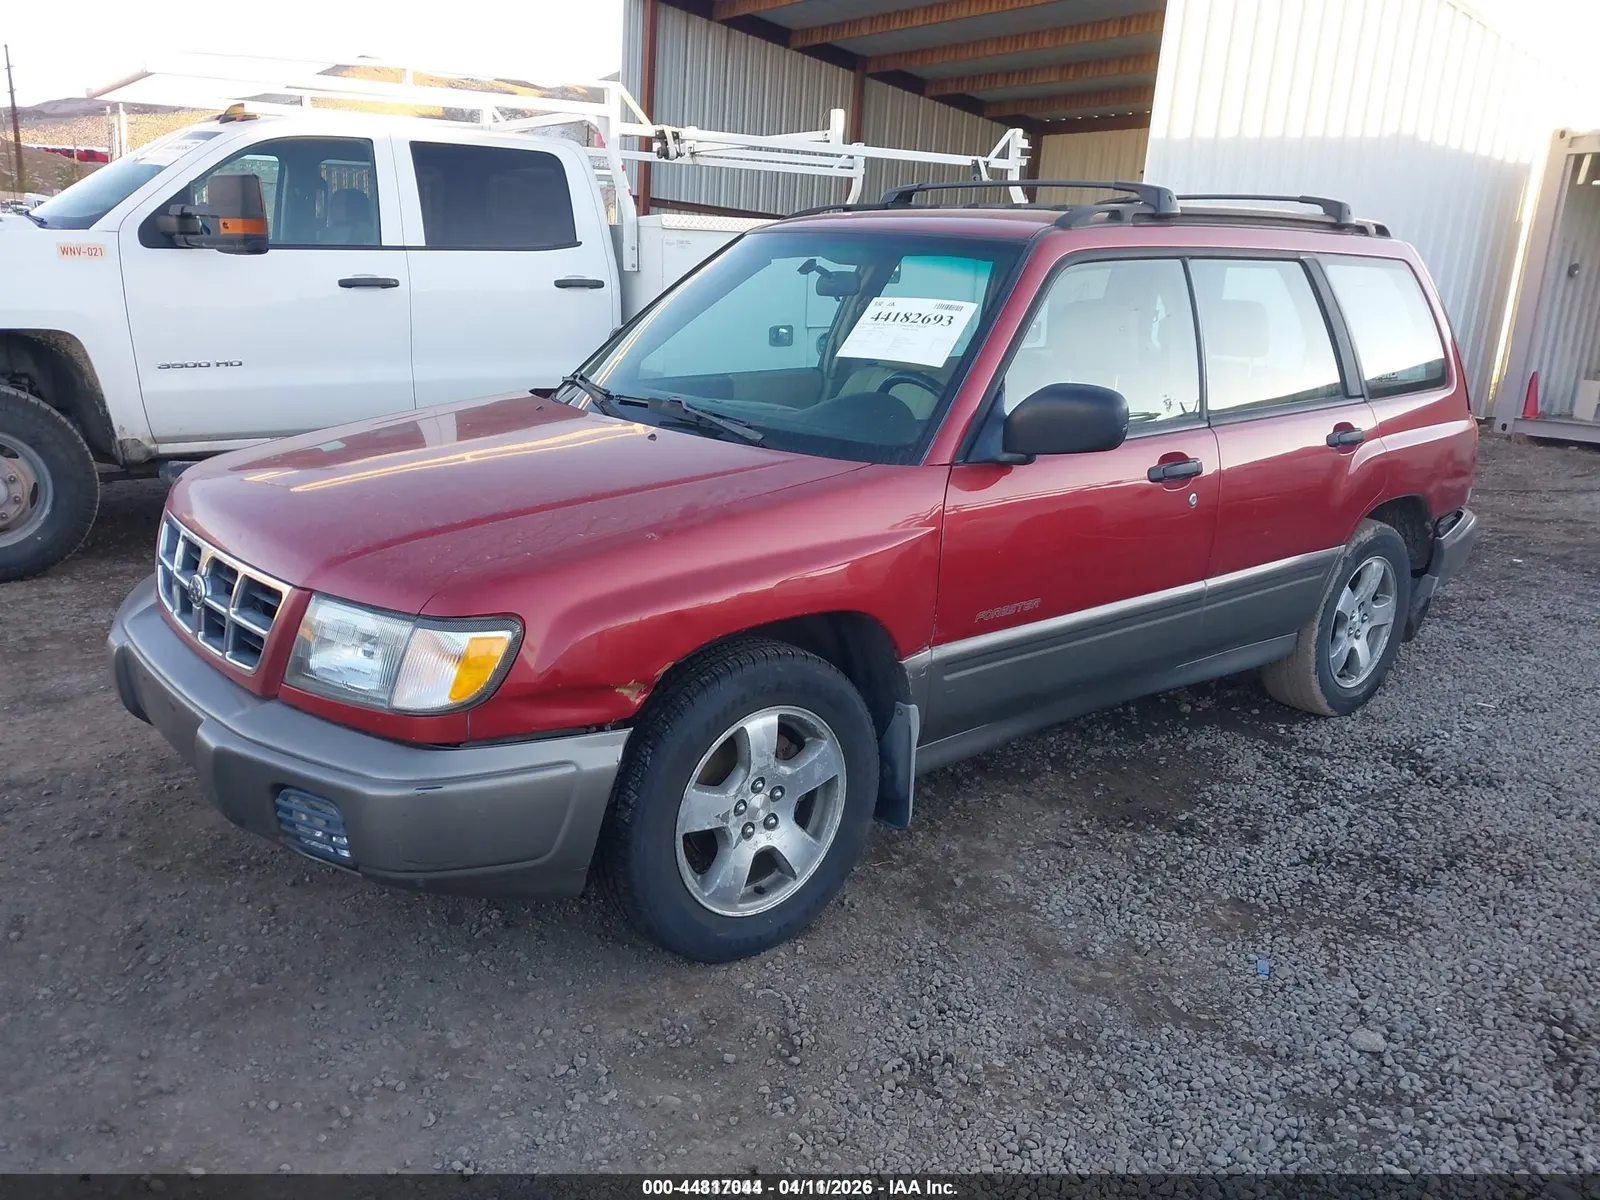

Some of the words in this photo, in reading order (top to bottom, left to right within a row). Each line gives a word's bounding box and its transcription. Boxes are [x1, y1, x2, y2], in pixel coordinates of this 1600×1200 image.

[60, 246, 104, 257] WNV-021
[870, 310, 954, 327] 44182693
[157, 360, 211, 369] 3500
[215, 359, 243, 367] HD
[974, 598, 1042, 623] FORESTER
